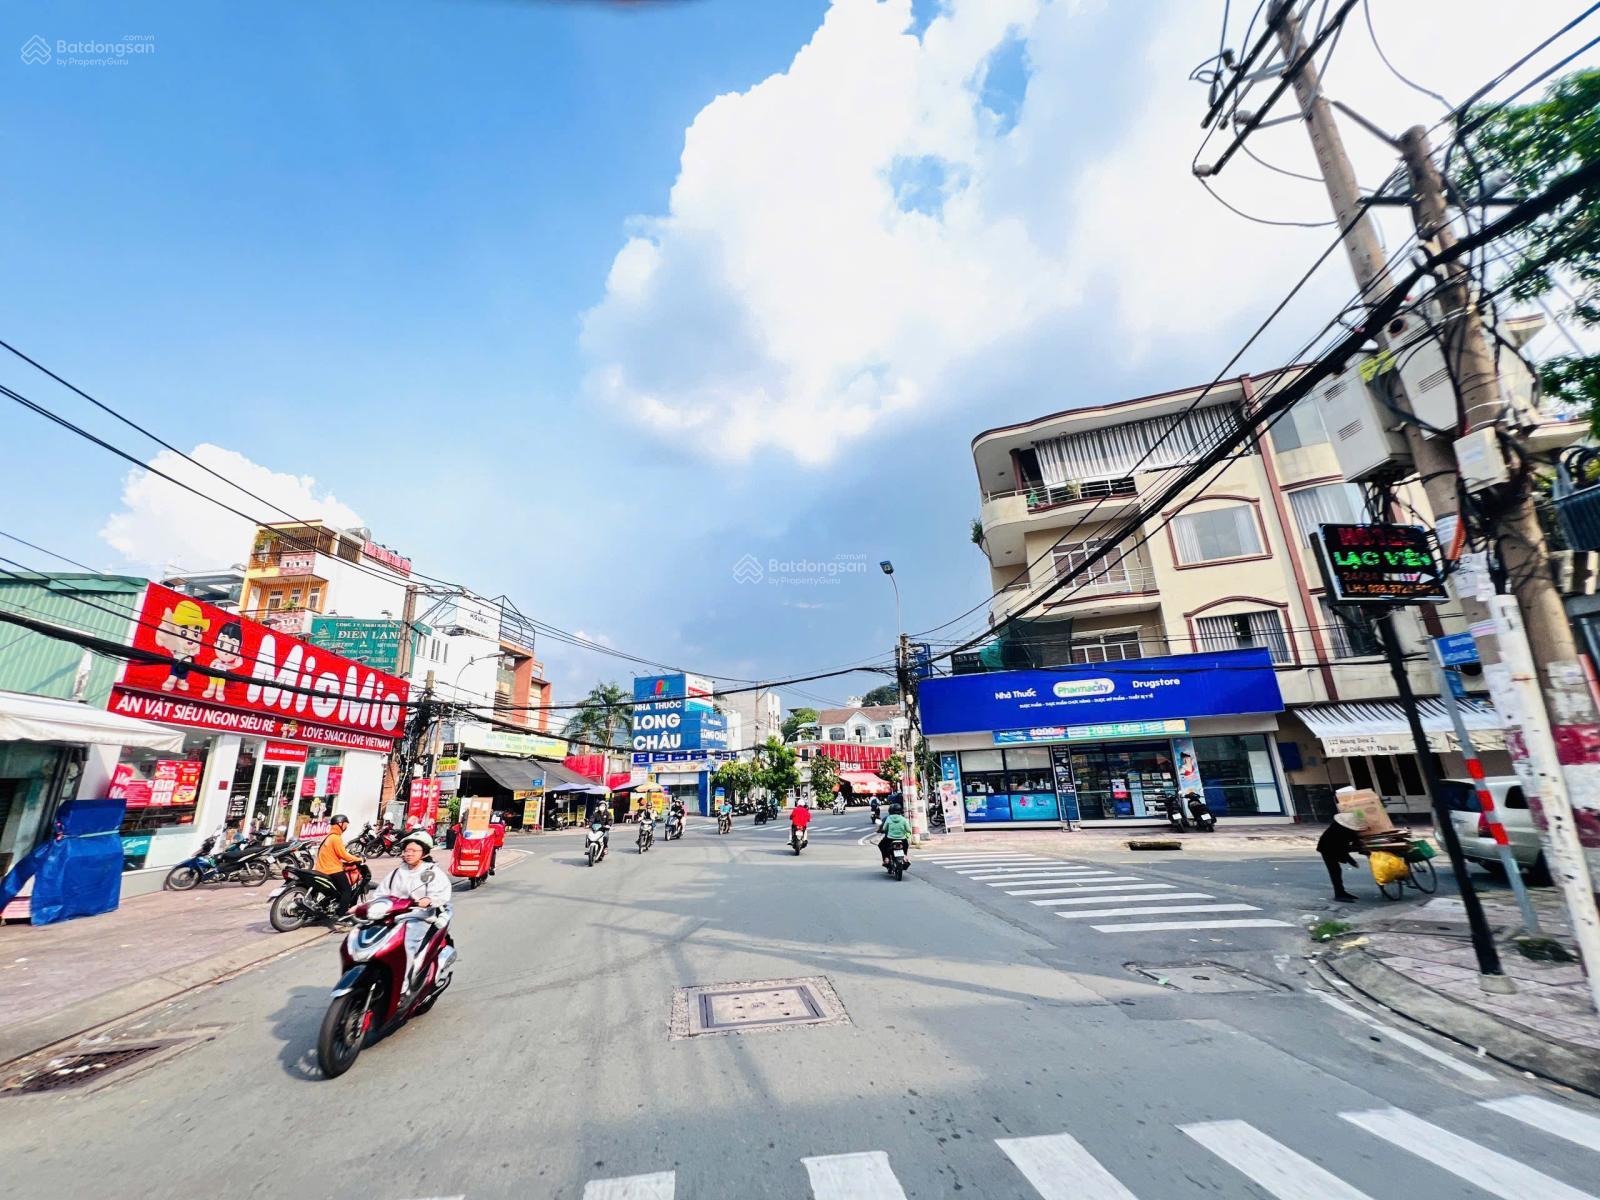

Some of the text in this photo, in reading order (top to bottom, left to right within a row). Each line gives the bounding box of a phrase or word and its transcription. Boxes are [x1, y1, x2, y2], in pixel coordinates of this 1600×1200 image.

[246, 634, 400, 731] MioMio
[1057, 681, 1109, 696] Pharmacity
[1132, 678, 1181, 689] Drugstore
[1012, 688, 1037, 699] Thuốc
[115, 691, 143, 713] ĂN
[172, 703, 203, 722] SIÊU
[202, 709, 241, 727] NGON
[240, 713, 263, 731] SIÊU
[262, 716, 276, 733] RẺ
[633, 713, 681, 730] LONG
[302, 726, 391, 749] LOVE SNACK LOVE VIETNAM
[633, 731, 681, 750] CHÂU
[301, 822, 331, 836] MioMio
